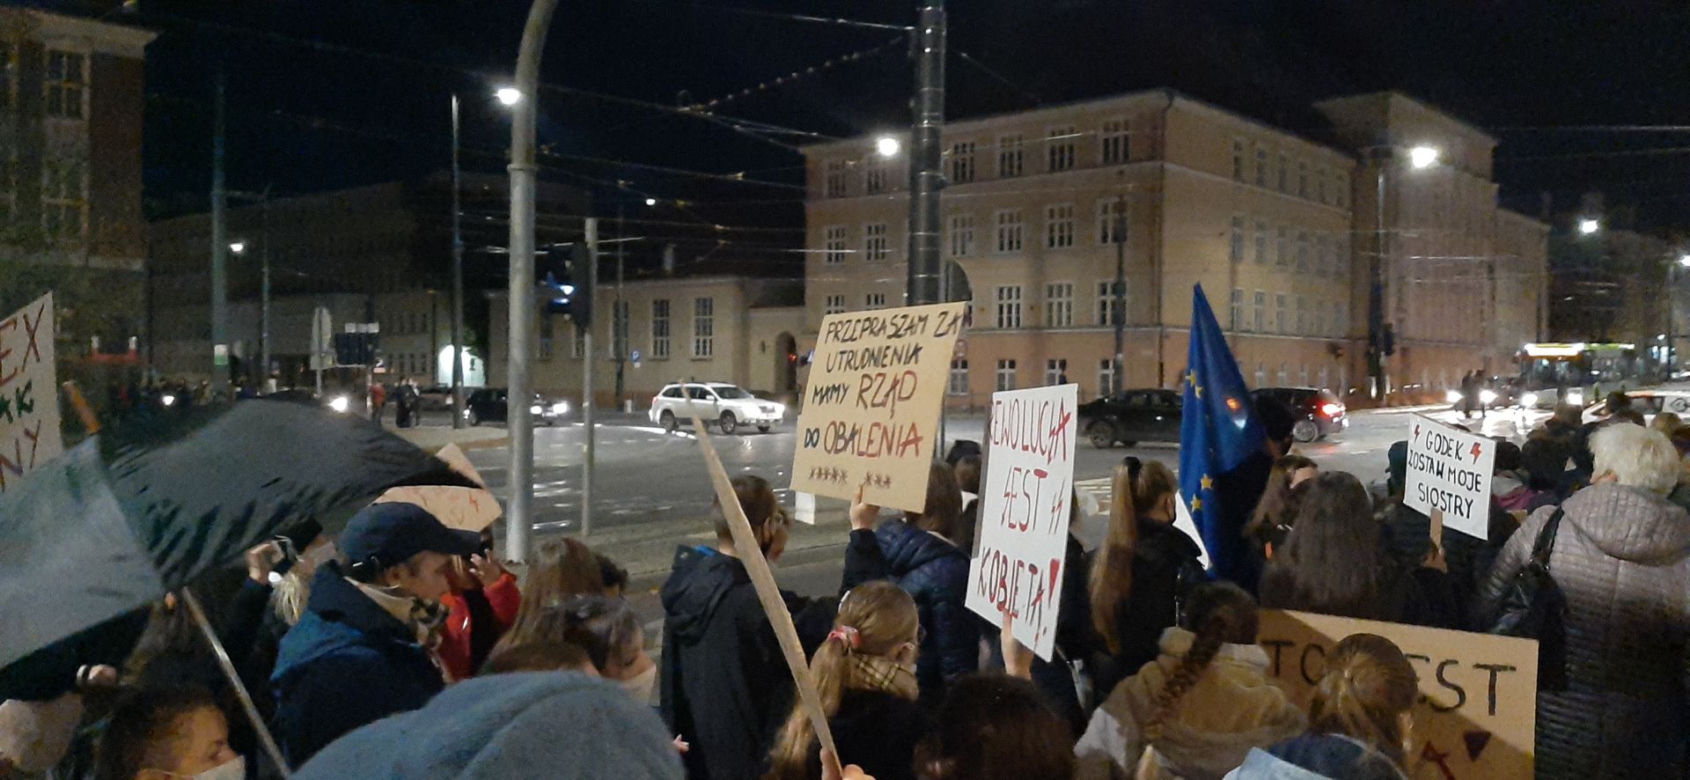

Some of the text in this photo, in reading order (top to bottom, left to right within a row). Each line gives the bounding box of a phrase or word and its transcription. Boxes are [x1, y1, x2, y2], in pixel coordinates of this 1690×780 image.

[824, 310, 964, 344] PRZEPRASZAM ZA
[826, 342, 923, 373] UTRUDNIENIA
[811, 370, 918, 419] MAMY RZĄD
[804, 420, 924, 458] DO OBALENIA
[1425, 430, 1464, 461] GODEK
[1408, 449, 1482, 493] ZOSTAW MOJE
[1418, 482, 1474, 519] SIOSTRY
[977, 546, 1060, 650] KOBIETA!
